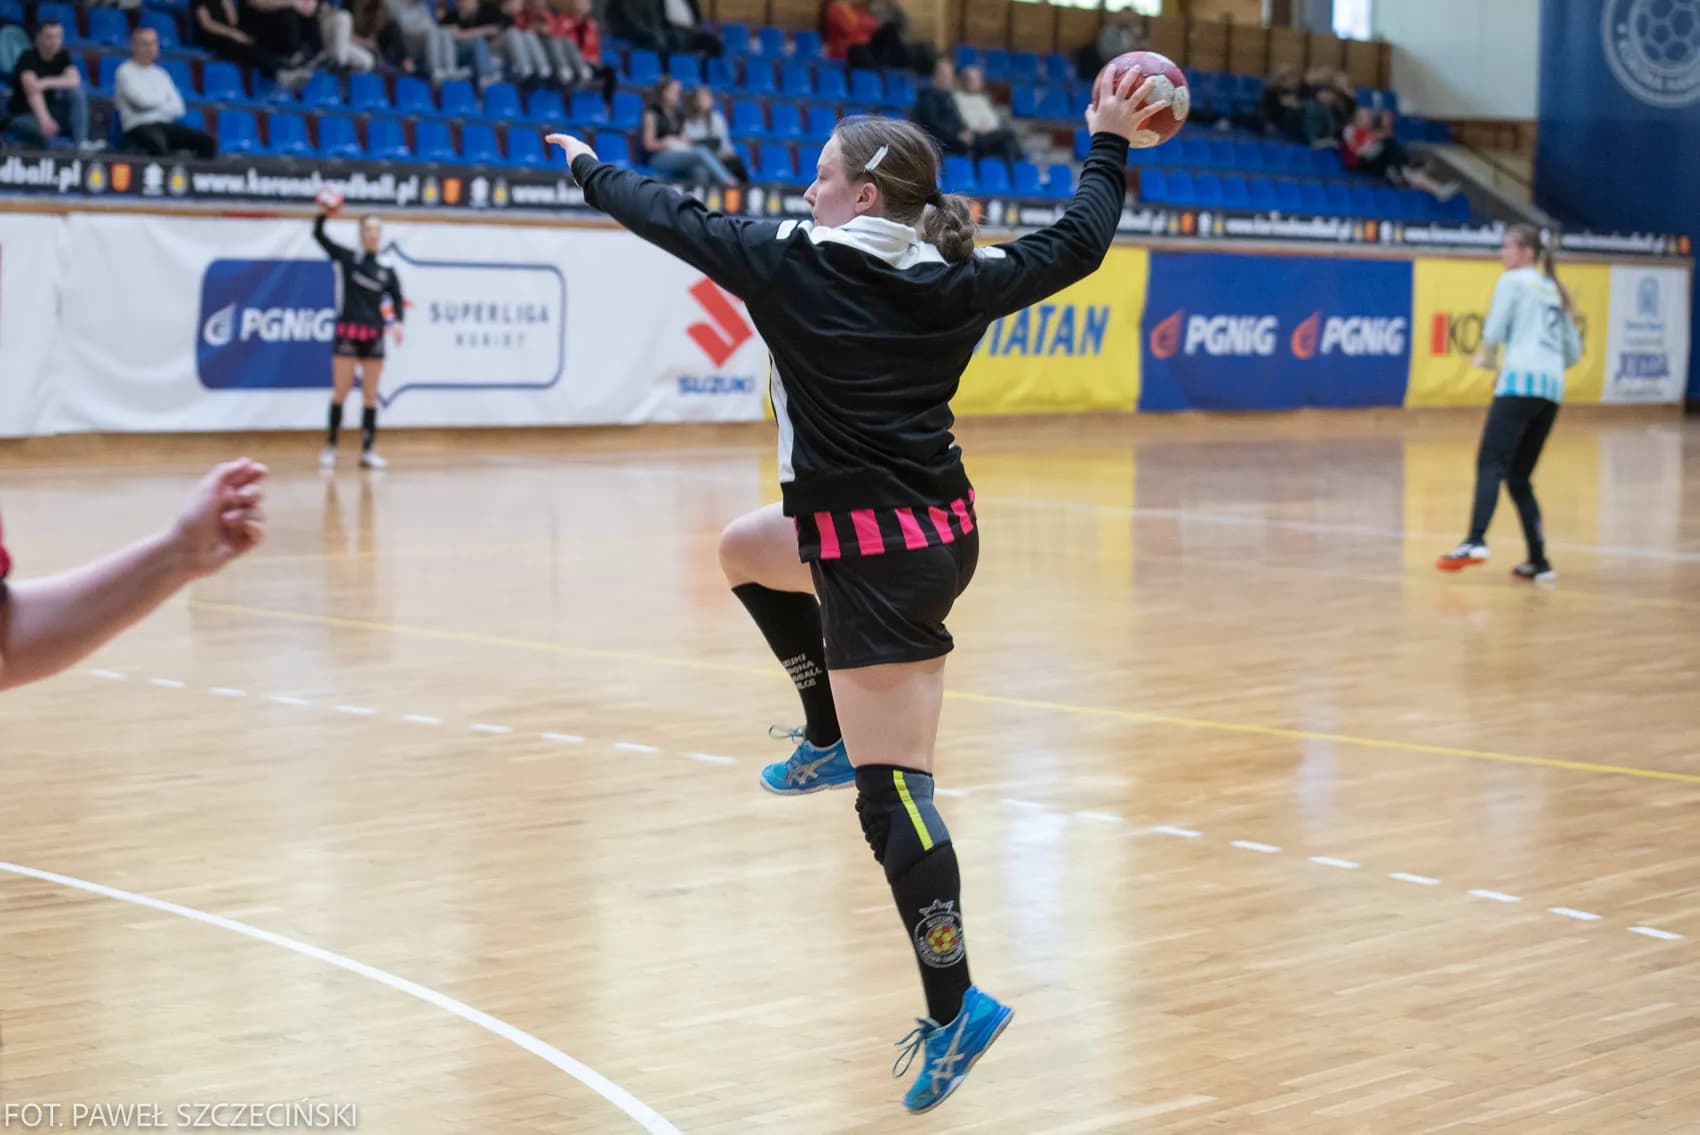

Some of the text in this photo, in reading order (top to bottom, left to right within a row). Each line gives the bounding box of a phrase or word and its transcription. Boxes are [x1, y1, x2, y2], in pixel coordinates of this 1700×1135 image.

[240, 307, 335, 342] PGNiG
[430, 302, 549, 324] SUPERLIGA
[973, 304, 1110, 357] IATAN
[1184, 315, 1278, 356] PGNiG
[1320, 315, 1405, 356] PGNiG
[678, 376, 755, 395] SUZUKI
